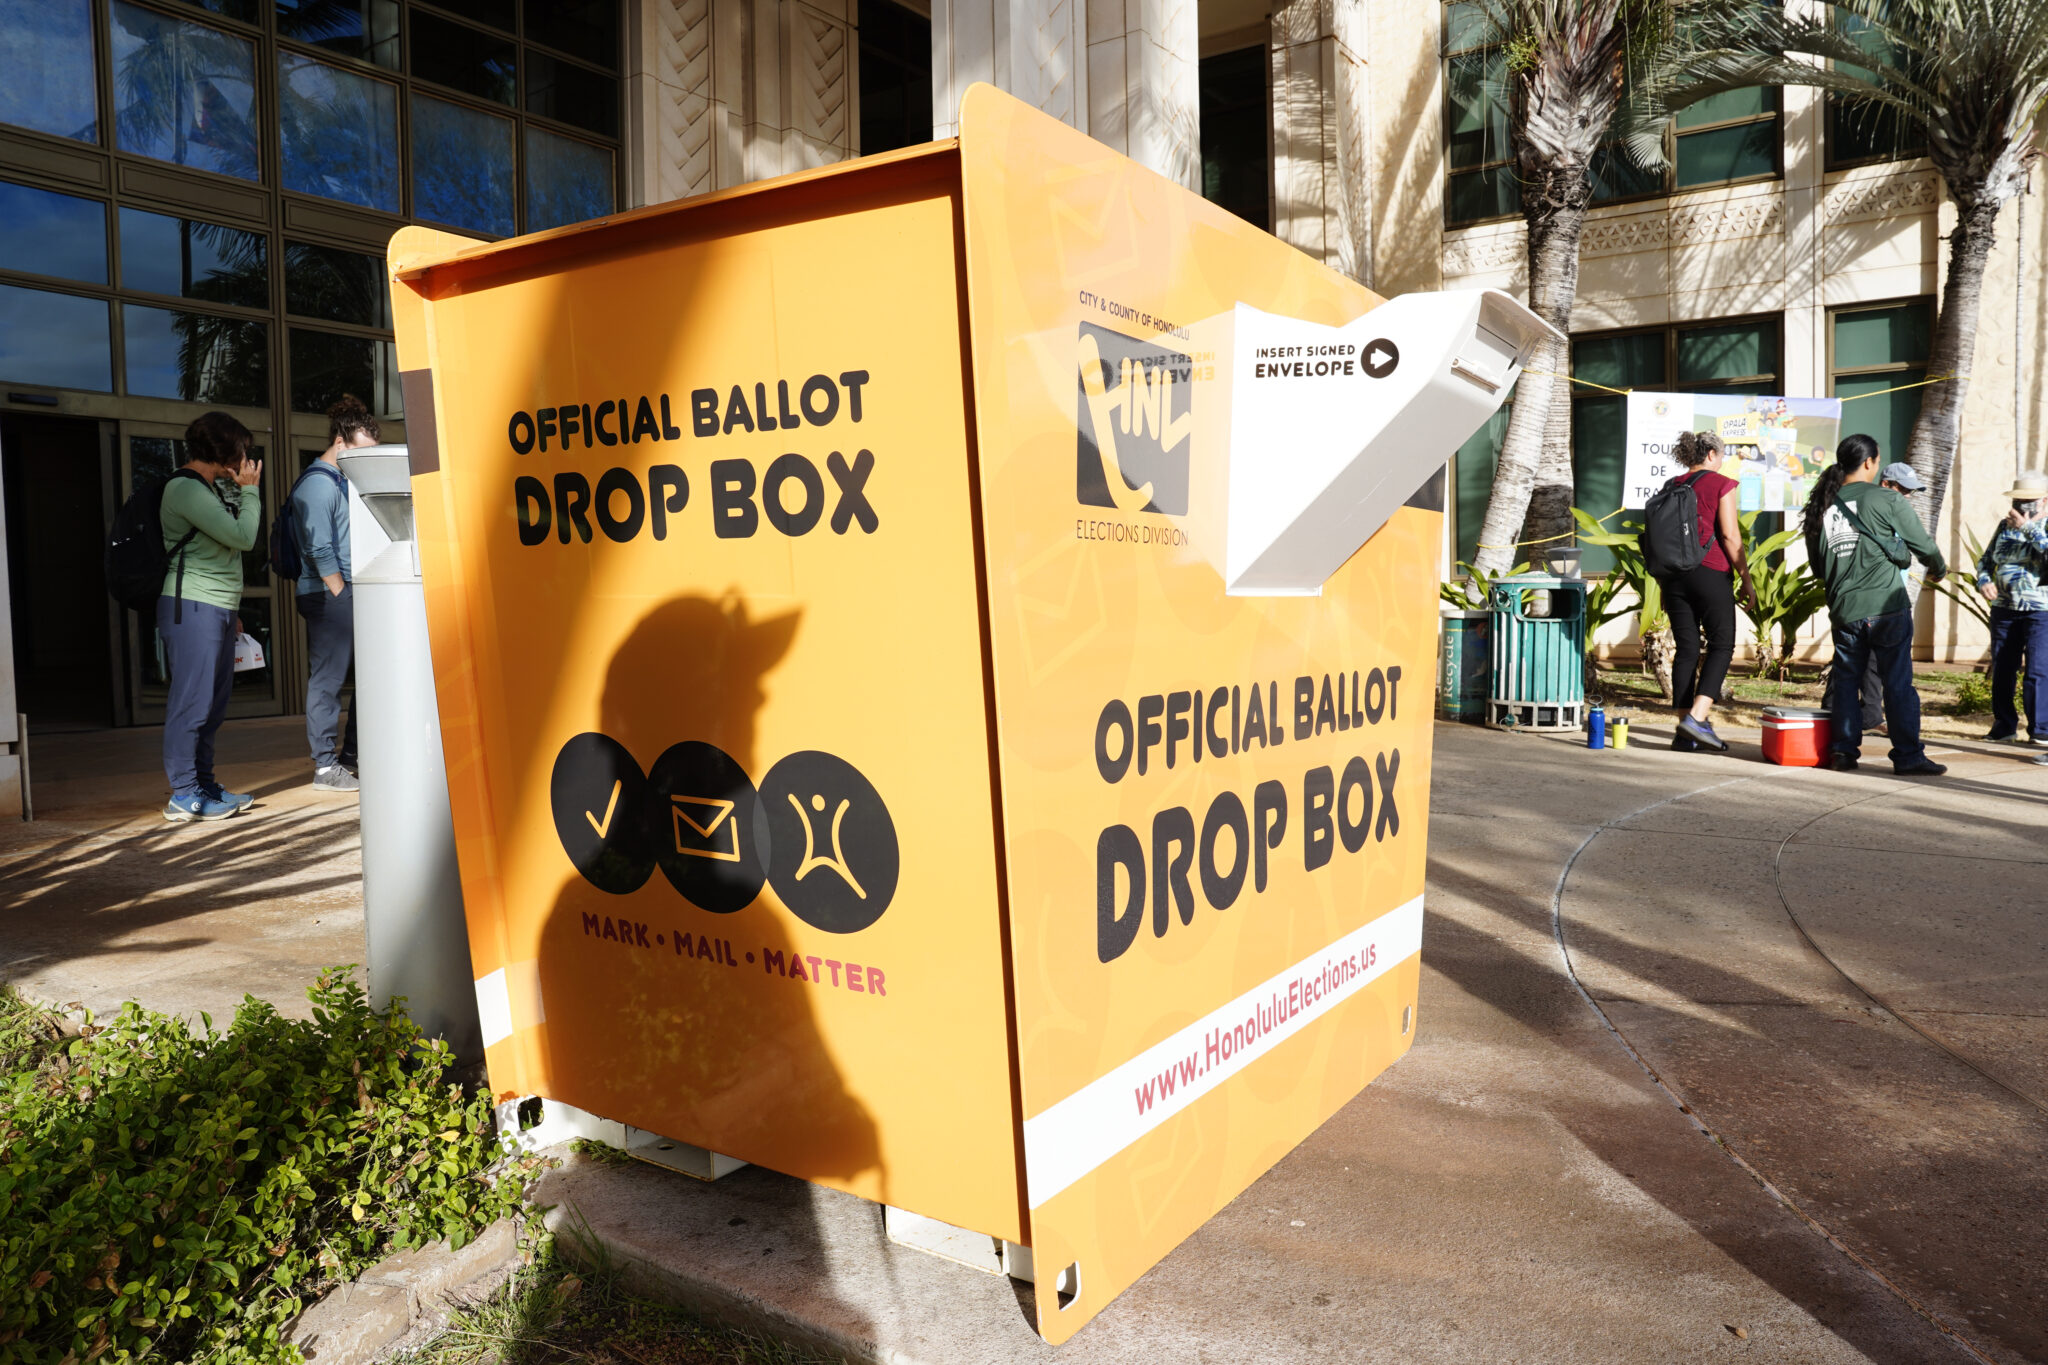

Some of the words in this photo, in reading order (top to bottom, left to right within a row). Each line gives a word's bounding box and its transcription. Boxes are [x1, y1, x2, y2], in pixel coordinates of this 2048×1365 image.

[1079, 290, 1098, 308] CITY
[1100, 298, 1106, 311] &
[1109, 301, 1140, 323] COUNTY
[1141, 313, 1152, 327] OF
[1153, 317, 1190, 341] HONOLULU
[1256, 346, 1302, 358] INSERT
[1307, 344, 1355, 357] SIGNED
[1255, 360, 1355, 378] ENVELOPE
[508, 393, 681, 455] OFFICIAL
[691, 369, 870, 438] BALLOT
[514, 464, 690, 546] DROP
[710, 448, 879, 539] BOX
[1650, 465, 1667, 477] DE
[1076, 519, 1139, 543] ELECTIONS
[1143, 525, 1189, 546] DIVISION
[1443, 635, 1457, 698] Recycle
[1095, 680, 1284, 785] OFFICIAL
[1294, 665, 1402, 741] BALLOT
[1097, 779, 1288, 964] DROP
[1304, 747, 1401, 873] BOX
[581, 911, 651, 949] MARK
[673, 930, 738, 967] MAIL
[762, 947, 888, 997] MATTER
[1134, 943, 1377, 1116] www.HonoluluElections.us
